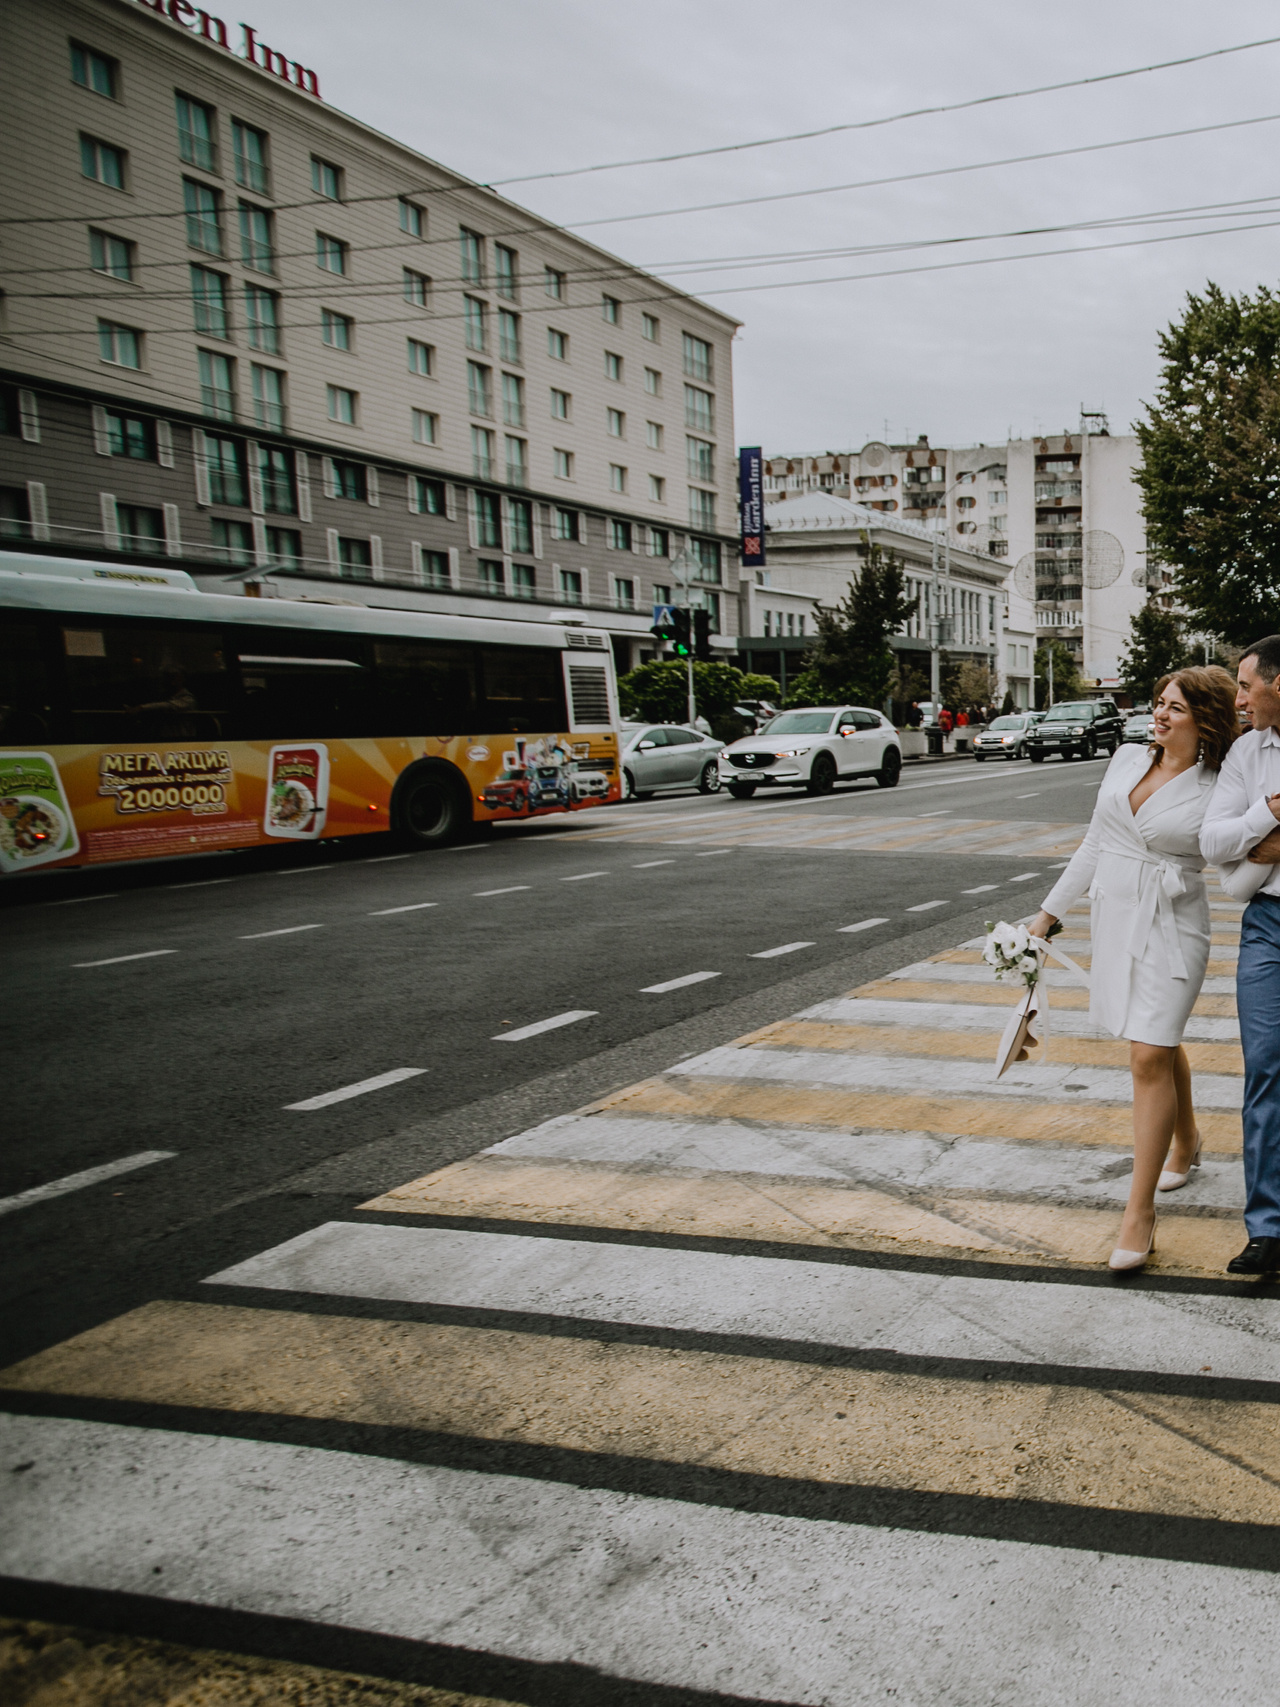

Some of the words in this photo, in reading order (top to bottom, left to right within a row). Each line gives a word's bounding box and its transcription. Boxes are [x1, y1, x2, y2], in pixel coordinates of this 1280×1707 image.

[238, 22, 322, 100] Inn
[749, 457, 760, 482] Inn
[750, 484, 761, 533] Garden
[104, 755, 160, 772] МЕГА
[165, 752, 230, 771] АКЦИЯ
